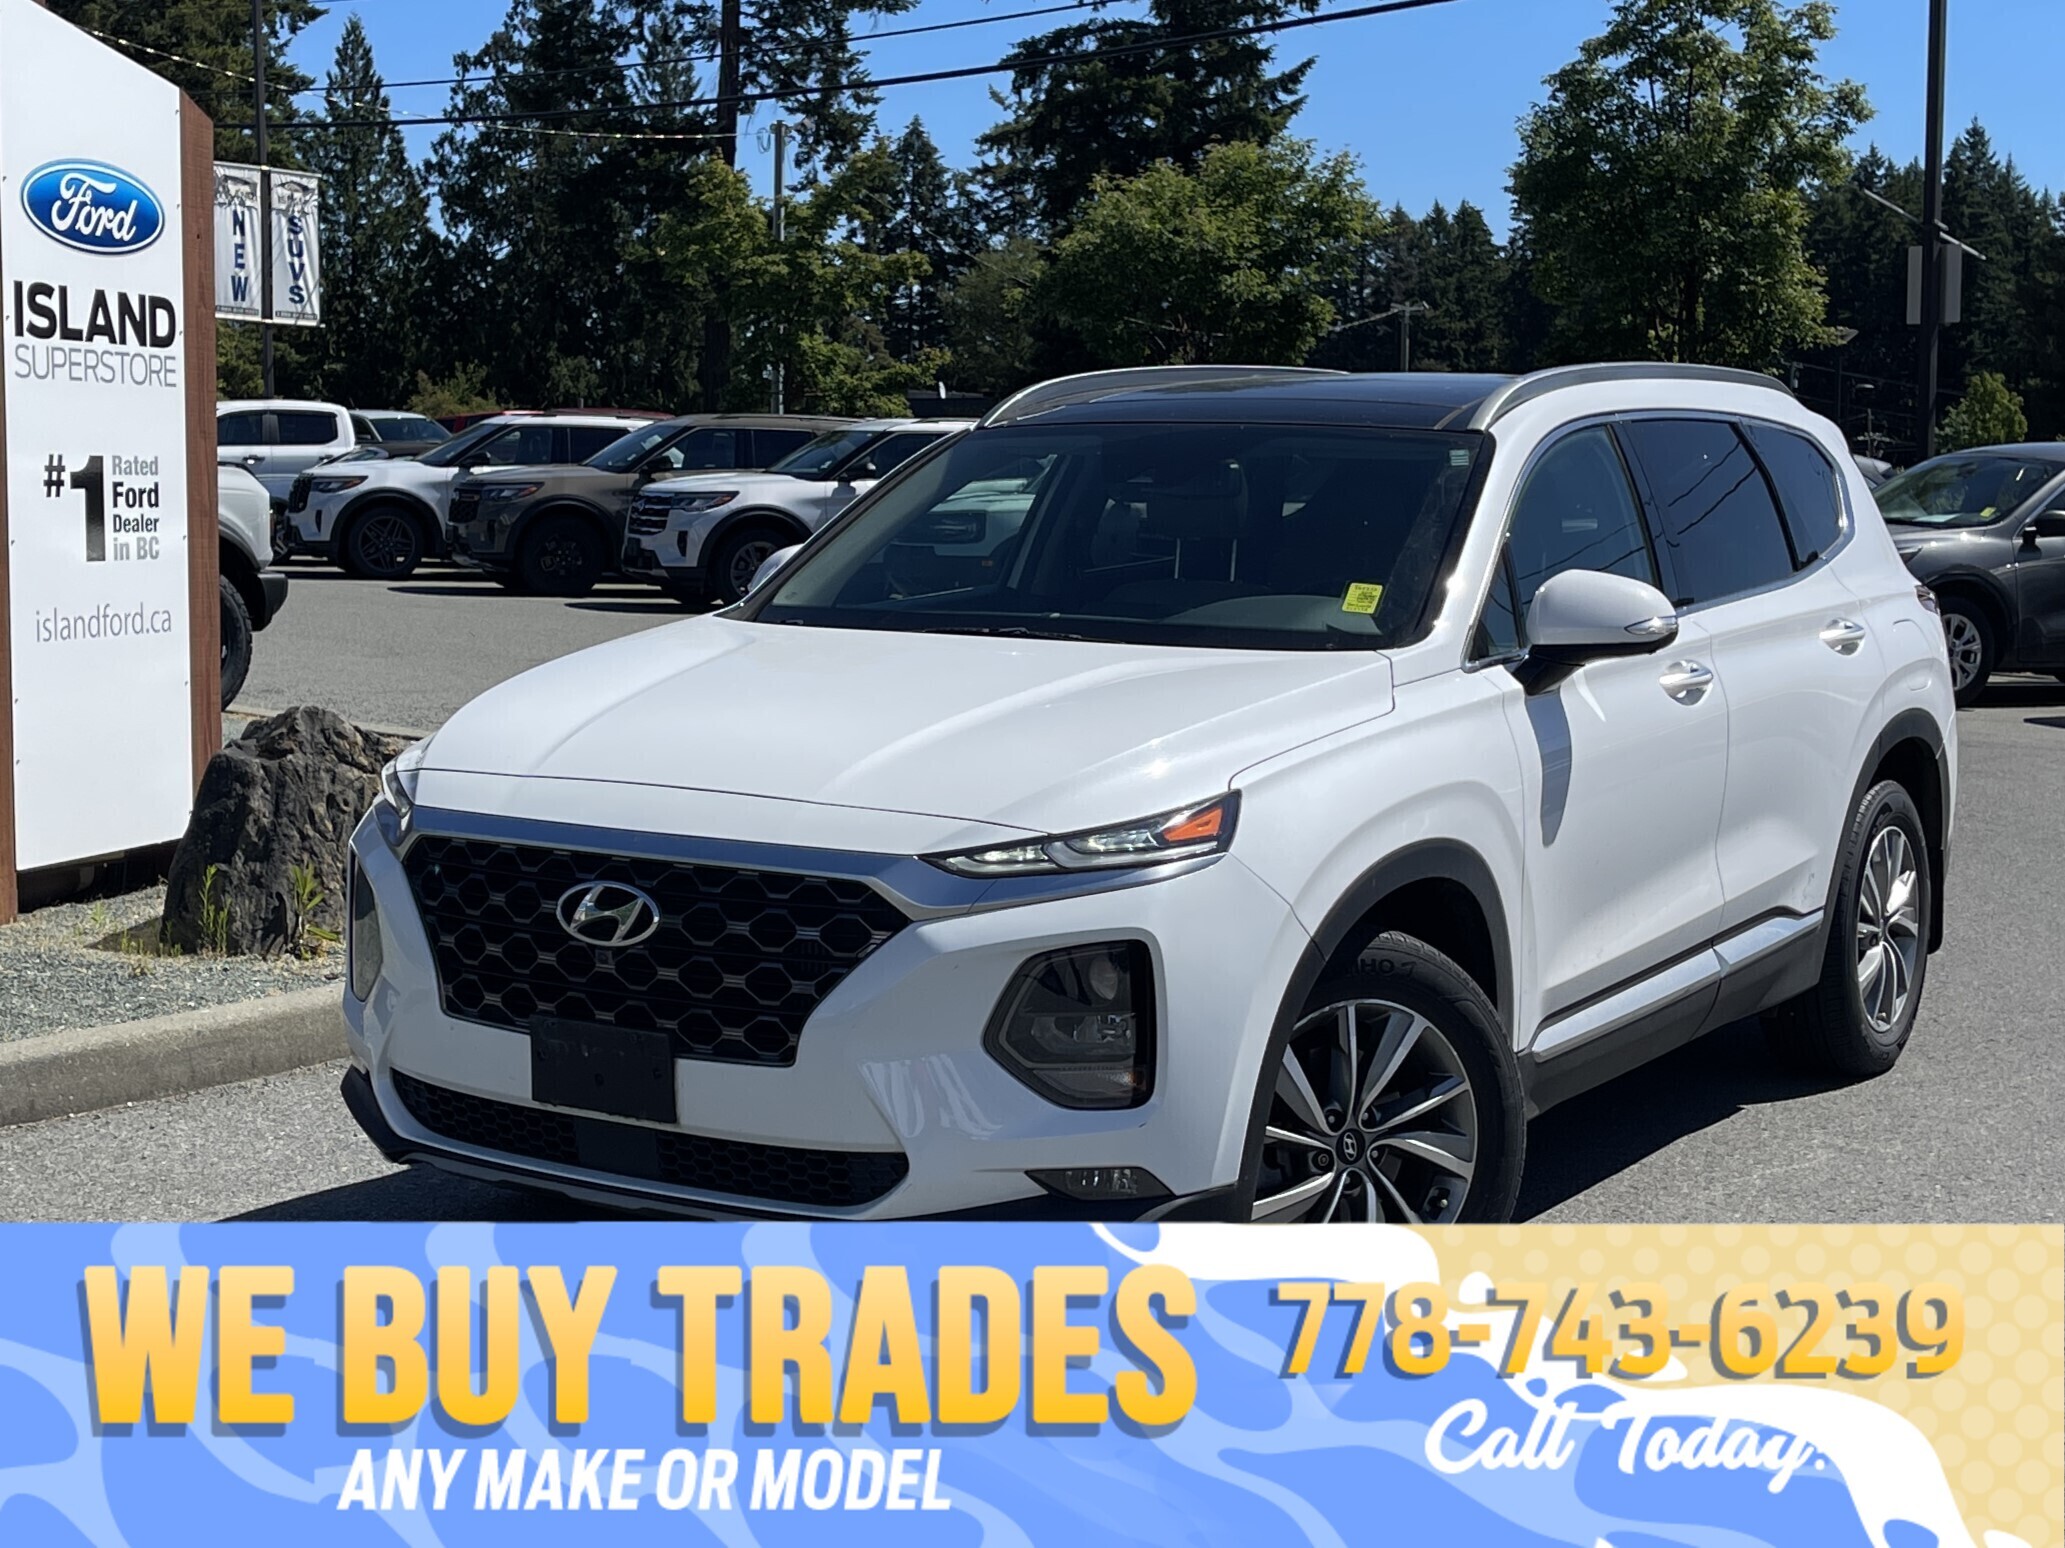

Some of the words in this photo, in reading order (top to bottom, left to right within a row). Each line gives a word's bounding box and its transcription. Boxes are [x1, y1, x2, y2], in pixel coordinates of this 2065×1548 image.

[50, 172, 138, 242] Ford
[230, 208, 249, 302] NEW
[287, 215, 306, 305] SUVS
[13, 280, 177, 350] ISLAND
[14, 343, 177, 388] SUPERSTORE
[112, 455, 159, 476] Rated
[112, 481, 160, 509] Ford
[112, 513, 160, 534] Dealer
[113, 537, 131, 561] in
[136, 536, 160, 561] BC
[35, 602, 172, 643] islandford.ca
